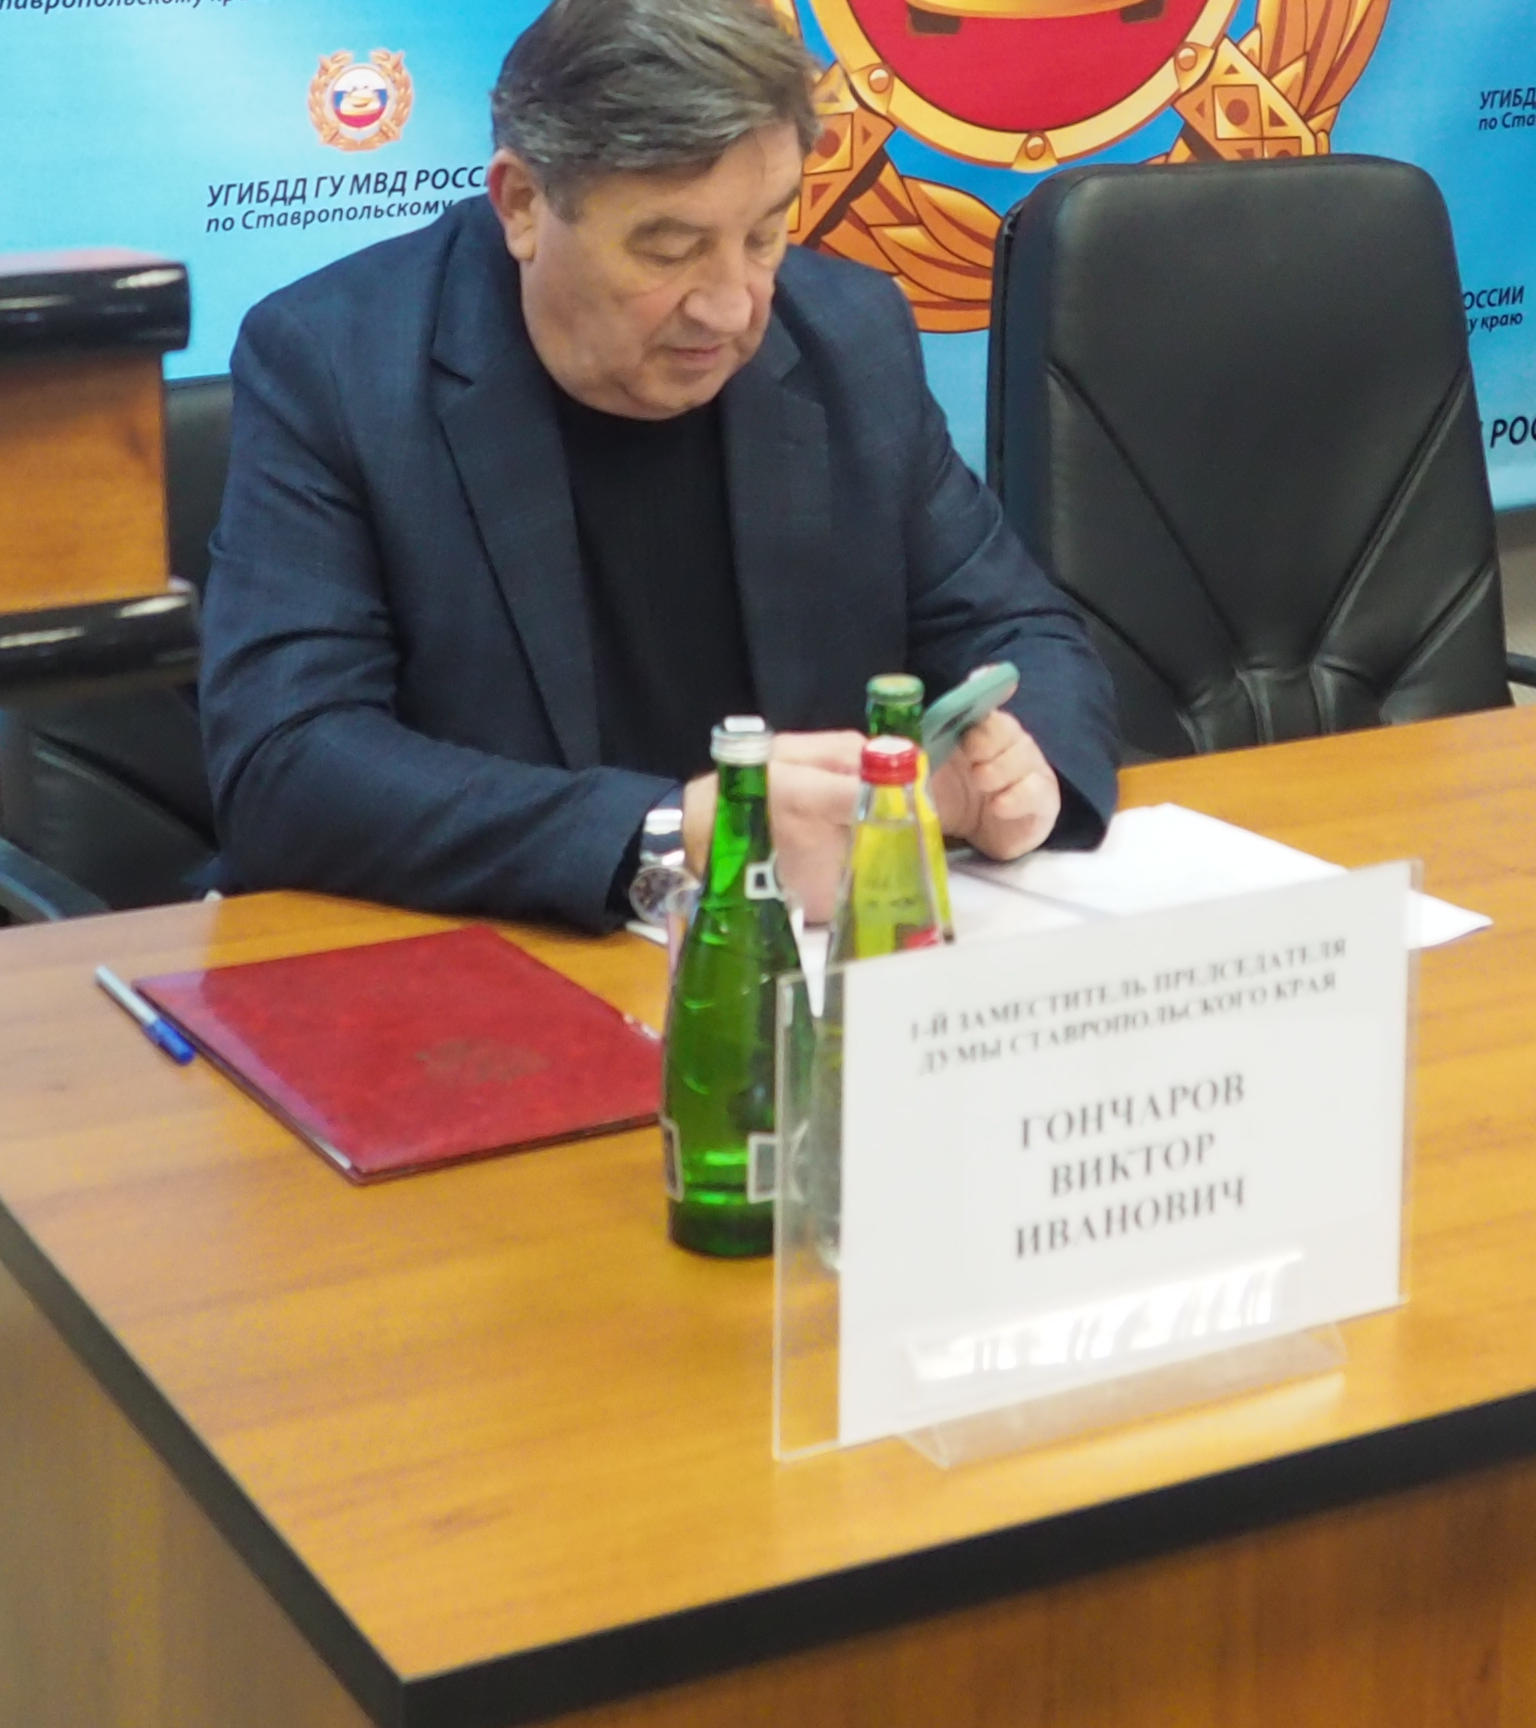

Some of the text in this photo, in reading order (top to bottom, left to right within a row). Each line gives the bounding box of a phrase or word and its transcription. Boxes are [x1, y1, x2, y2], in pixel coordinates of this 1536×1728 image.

[1479, 117, 1497, 130] по
[206, 165, 489, 207] УГИБДД ГУ МВД РОСС
[206, 216, 235, 233] по
[1463, 286, 1524, 310] ОССИИ
[1481, 313, 1523, 332] краю
[909, 937, 1347, 1043] 1-Й ЗАМЕСТИТЕЛЬ ПРЕДСЕДАТЕЛЯ
[920, 970, 1337, 1077] ДУМЫ СТАВРОПОЛЬСКОГО КРАЯ
[1019, 1072, 1247, 1151] ГОНЧАРОВ
[1049, 1132, 1217, 1200] ВИКТОР
[1014, 1177, 1249, 1261] ИВАНОВИЧ
